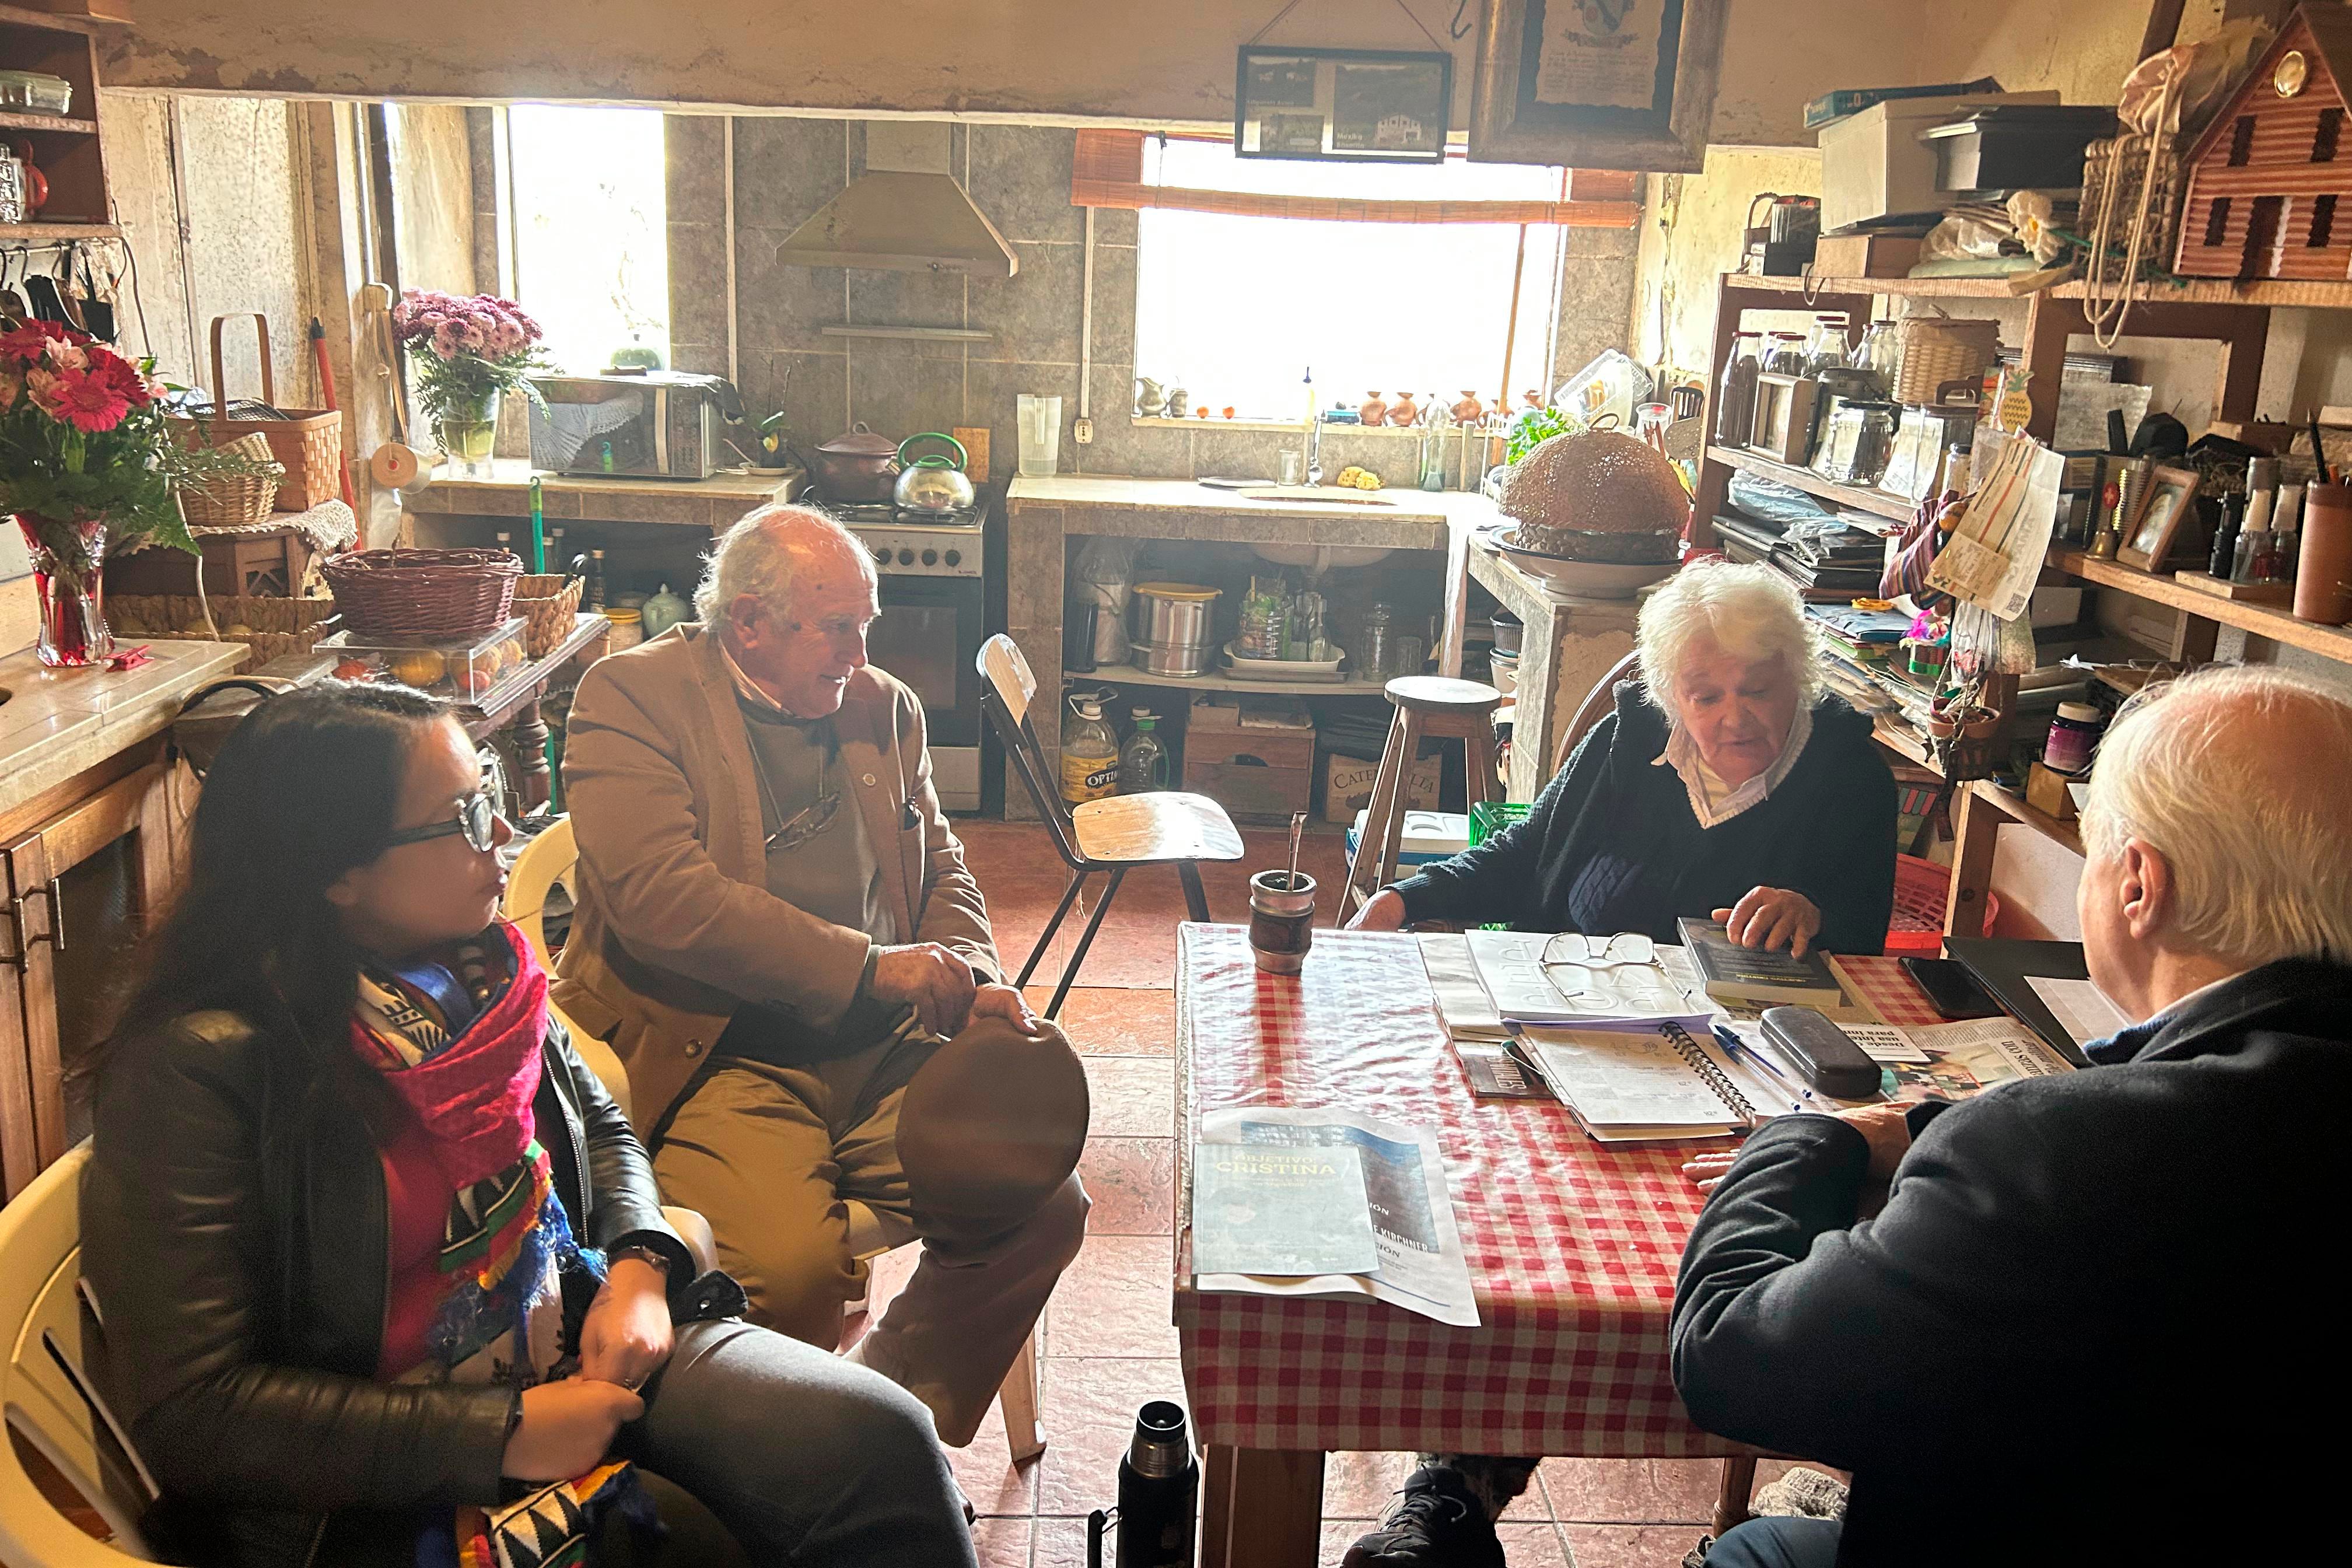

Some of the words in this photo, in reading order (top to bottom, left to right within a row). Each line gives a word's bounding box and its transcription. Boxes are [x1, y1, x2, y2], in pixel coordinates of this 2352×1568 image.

[2001, 1041, 2022, 1054] con
[2014, 1054, 2044, 1076] anzas
[1489, 1063, 1527, 1090] VITALES
[1216, 1161, 1336, 1175] CRISTINA
[1369, 1202, 1390, 1216] IÓN
[1381, 1227, 1429, 1254] KIRCHNER
